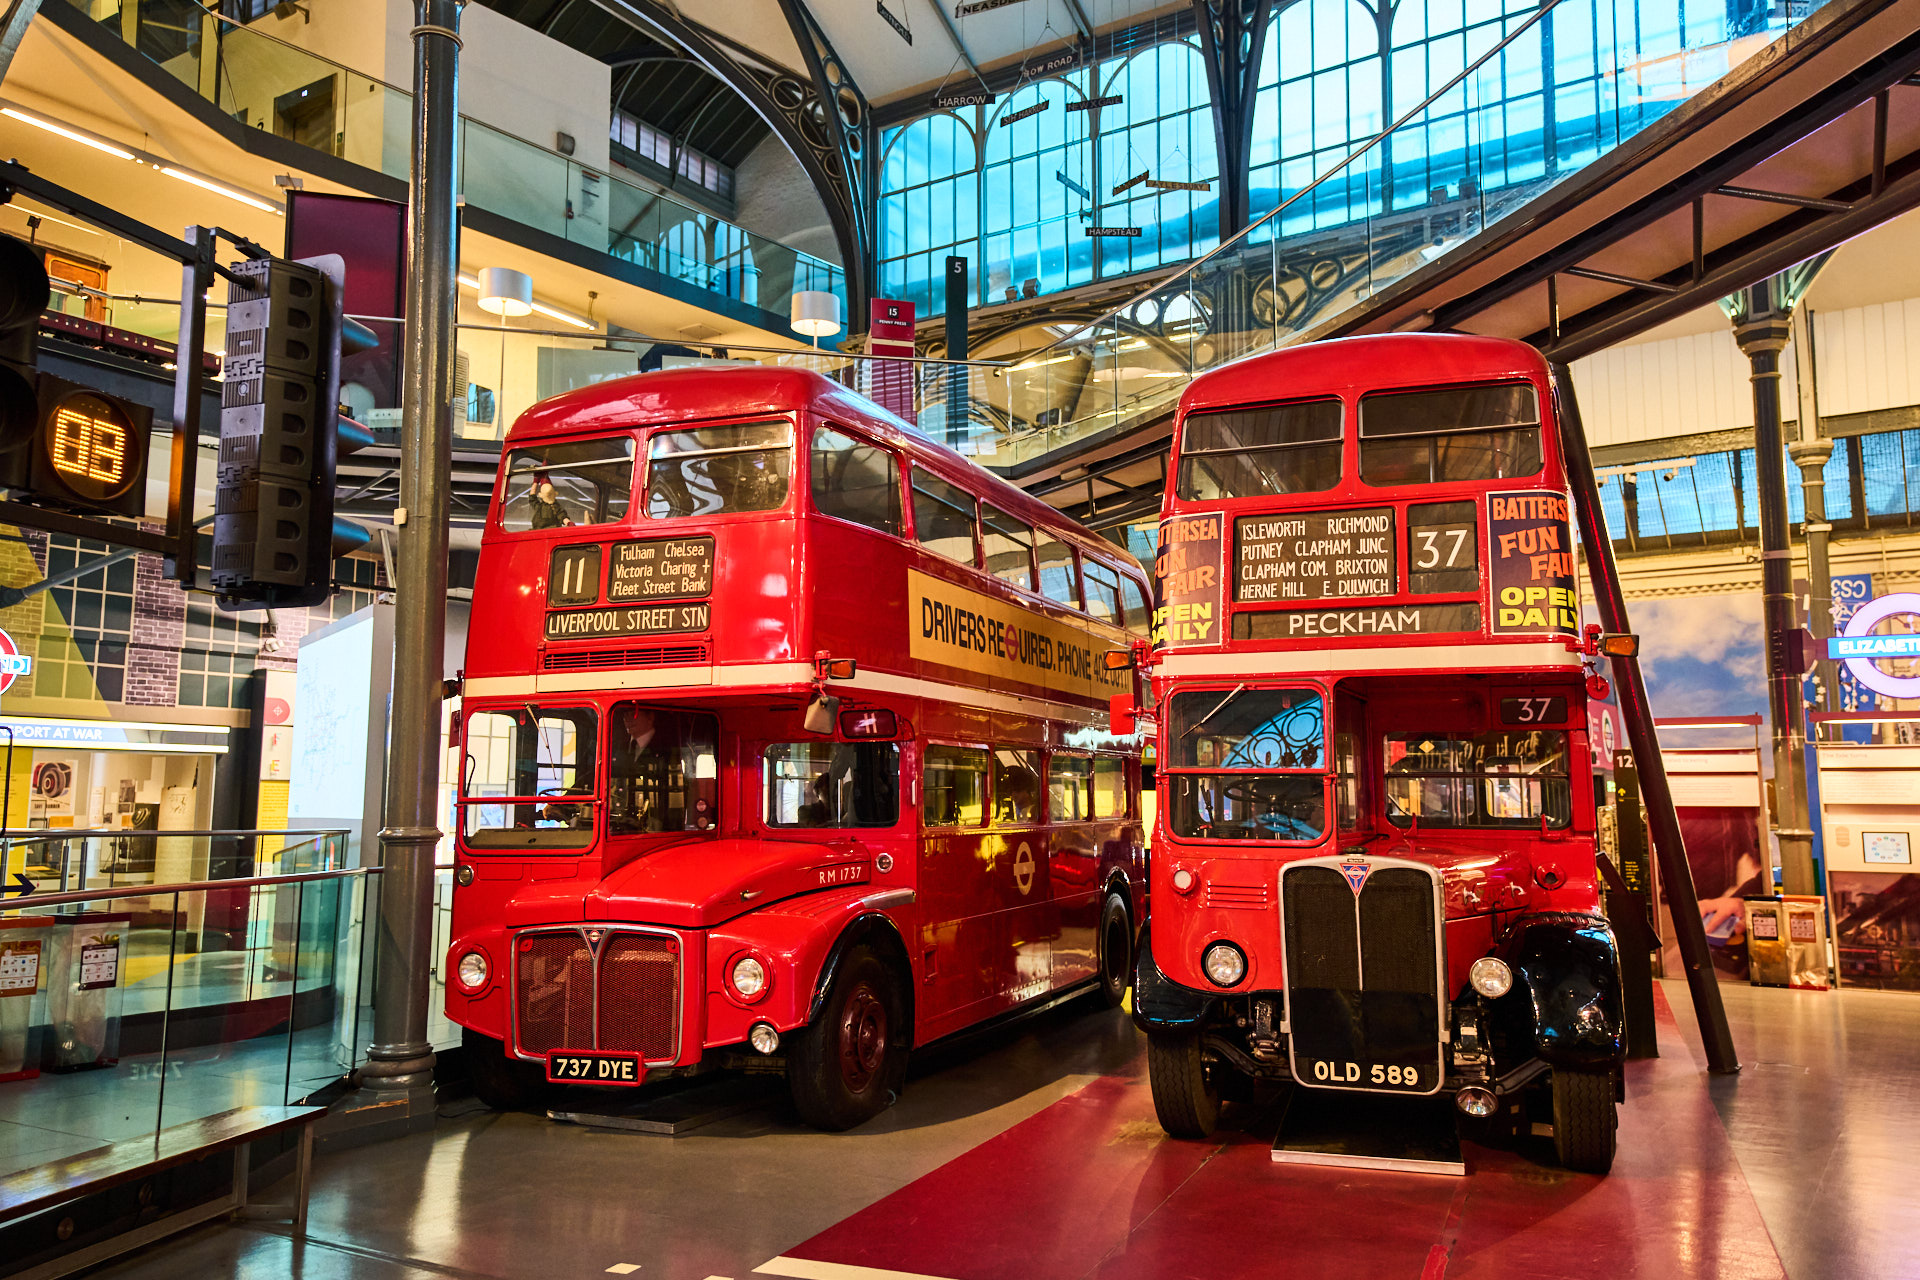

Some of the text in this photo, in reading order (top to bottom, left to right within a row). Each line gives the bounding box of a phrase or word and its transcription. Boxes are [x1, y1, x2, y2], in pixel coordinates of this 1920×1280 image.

[963, 0, 1019, 14] NEASD
[1048, 55, 1072, 70] ROAD
[938, 95, 986, 107] HARROW
[1152, 181, 1204, 190] AYLESBURY
[1089, 228, 1138, 236] HAMPSTEAD
[954, 261, 962, 274] 5
[889, 307, 898, 317] 15
[54, 409, 126, 484] 03
[1492, 496, 1568, 523] BATTERS
[1242, 515, 1389, 541] ISLEWORTH RICHMOND
[620, 542, 705, 562] Fulham Chelsea
[1241, 541, 1283, 561] PUTNEY
[1295, 538, 1351, 557] CLAPHAM
[1417, 529, 1467, 569] 37
[1498, 525, 1560, 559] FUN
[615, 563, 653, 579] Victoria
[660, 560, 697, 578] Charing
[1155, 547, 1187, 579] UN
[1241, 558, 1388, 581] CLAPHAM COM. BRIXTON
[562, 557, 585, 595] 11
[612, 577, 707, 596] Fleet Street Bank
[1161, 564, 1217, 602] FAIR
[1240, 582, 1278, 600] HERNE
[1282, 581, 1306, 598] HILL
[1338, 578, 1389, 596] DULWICH
[548, 607, 707, 634] LIVERPOOL STREET STN
[1289, 610, 1420, 635] PECKHAM
[922, 597, 986, 653] DRIVERS
[1058, 641, 1092, 680] PHONE
[1838, 637, 1920, 655] ELIZABET
[1517, 697, 1552, 722] 37
[53, 727, 70, 739] AT
[72, 728, 103, 740] WAR
[1616, 754, 1633, 768] 12
[819, 866, 861, 884] RM 1737
[556, 1058, 634, 1080] 737 DYE
[1314, 1060, 1418, 1086] OLD 589
